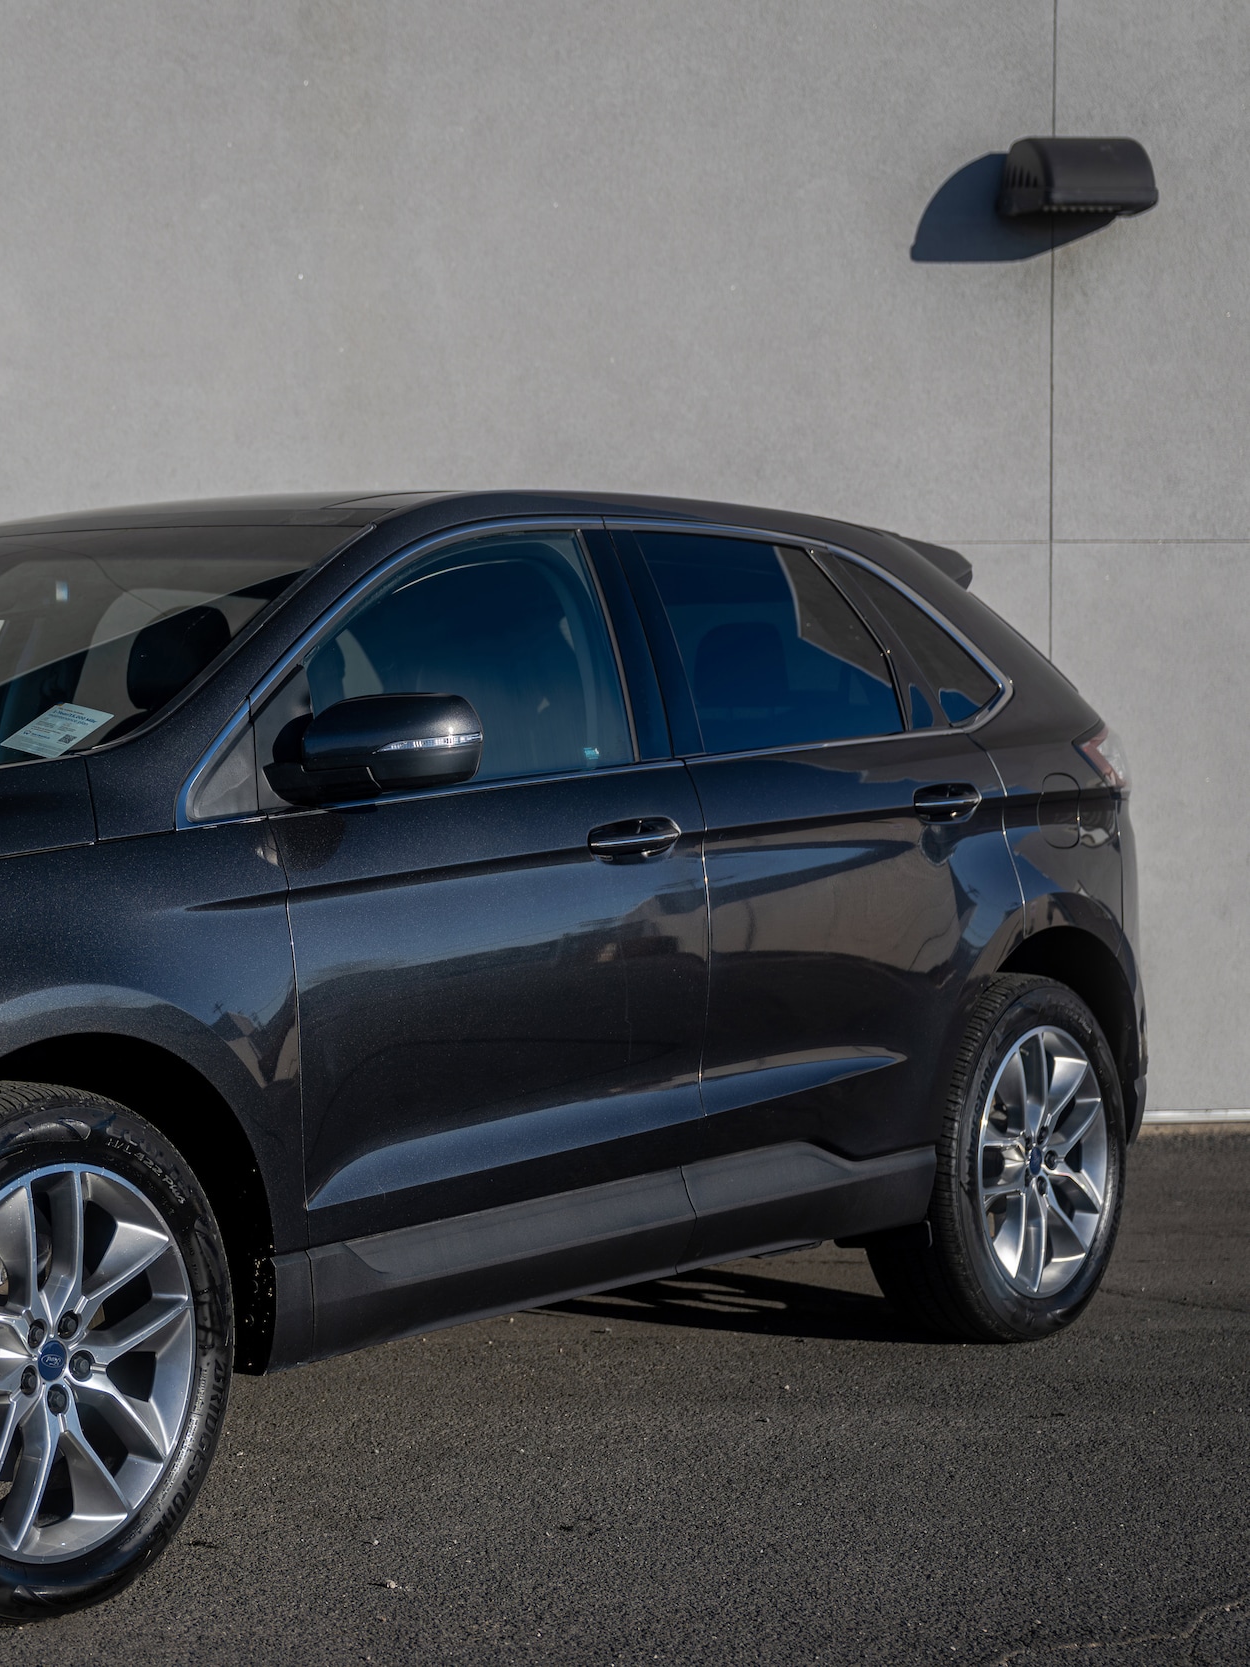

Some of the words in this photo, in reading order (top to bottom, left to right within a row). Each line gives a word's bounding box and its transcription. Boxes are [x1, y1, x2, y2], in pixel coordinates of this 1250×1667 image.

[134, 1151, 163, 1177] 422
[161, 1174, 186, 1205] Plus
[151, 1357, 227, 1544] BRIDGESTONE
